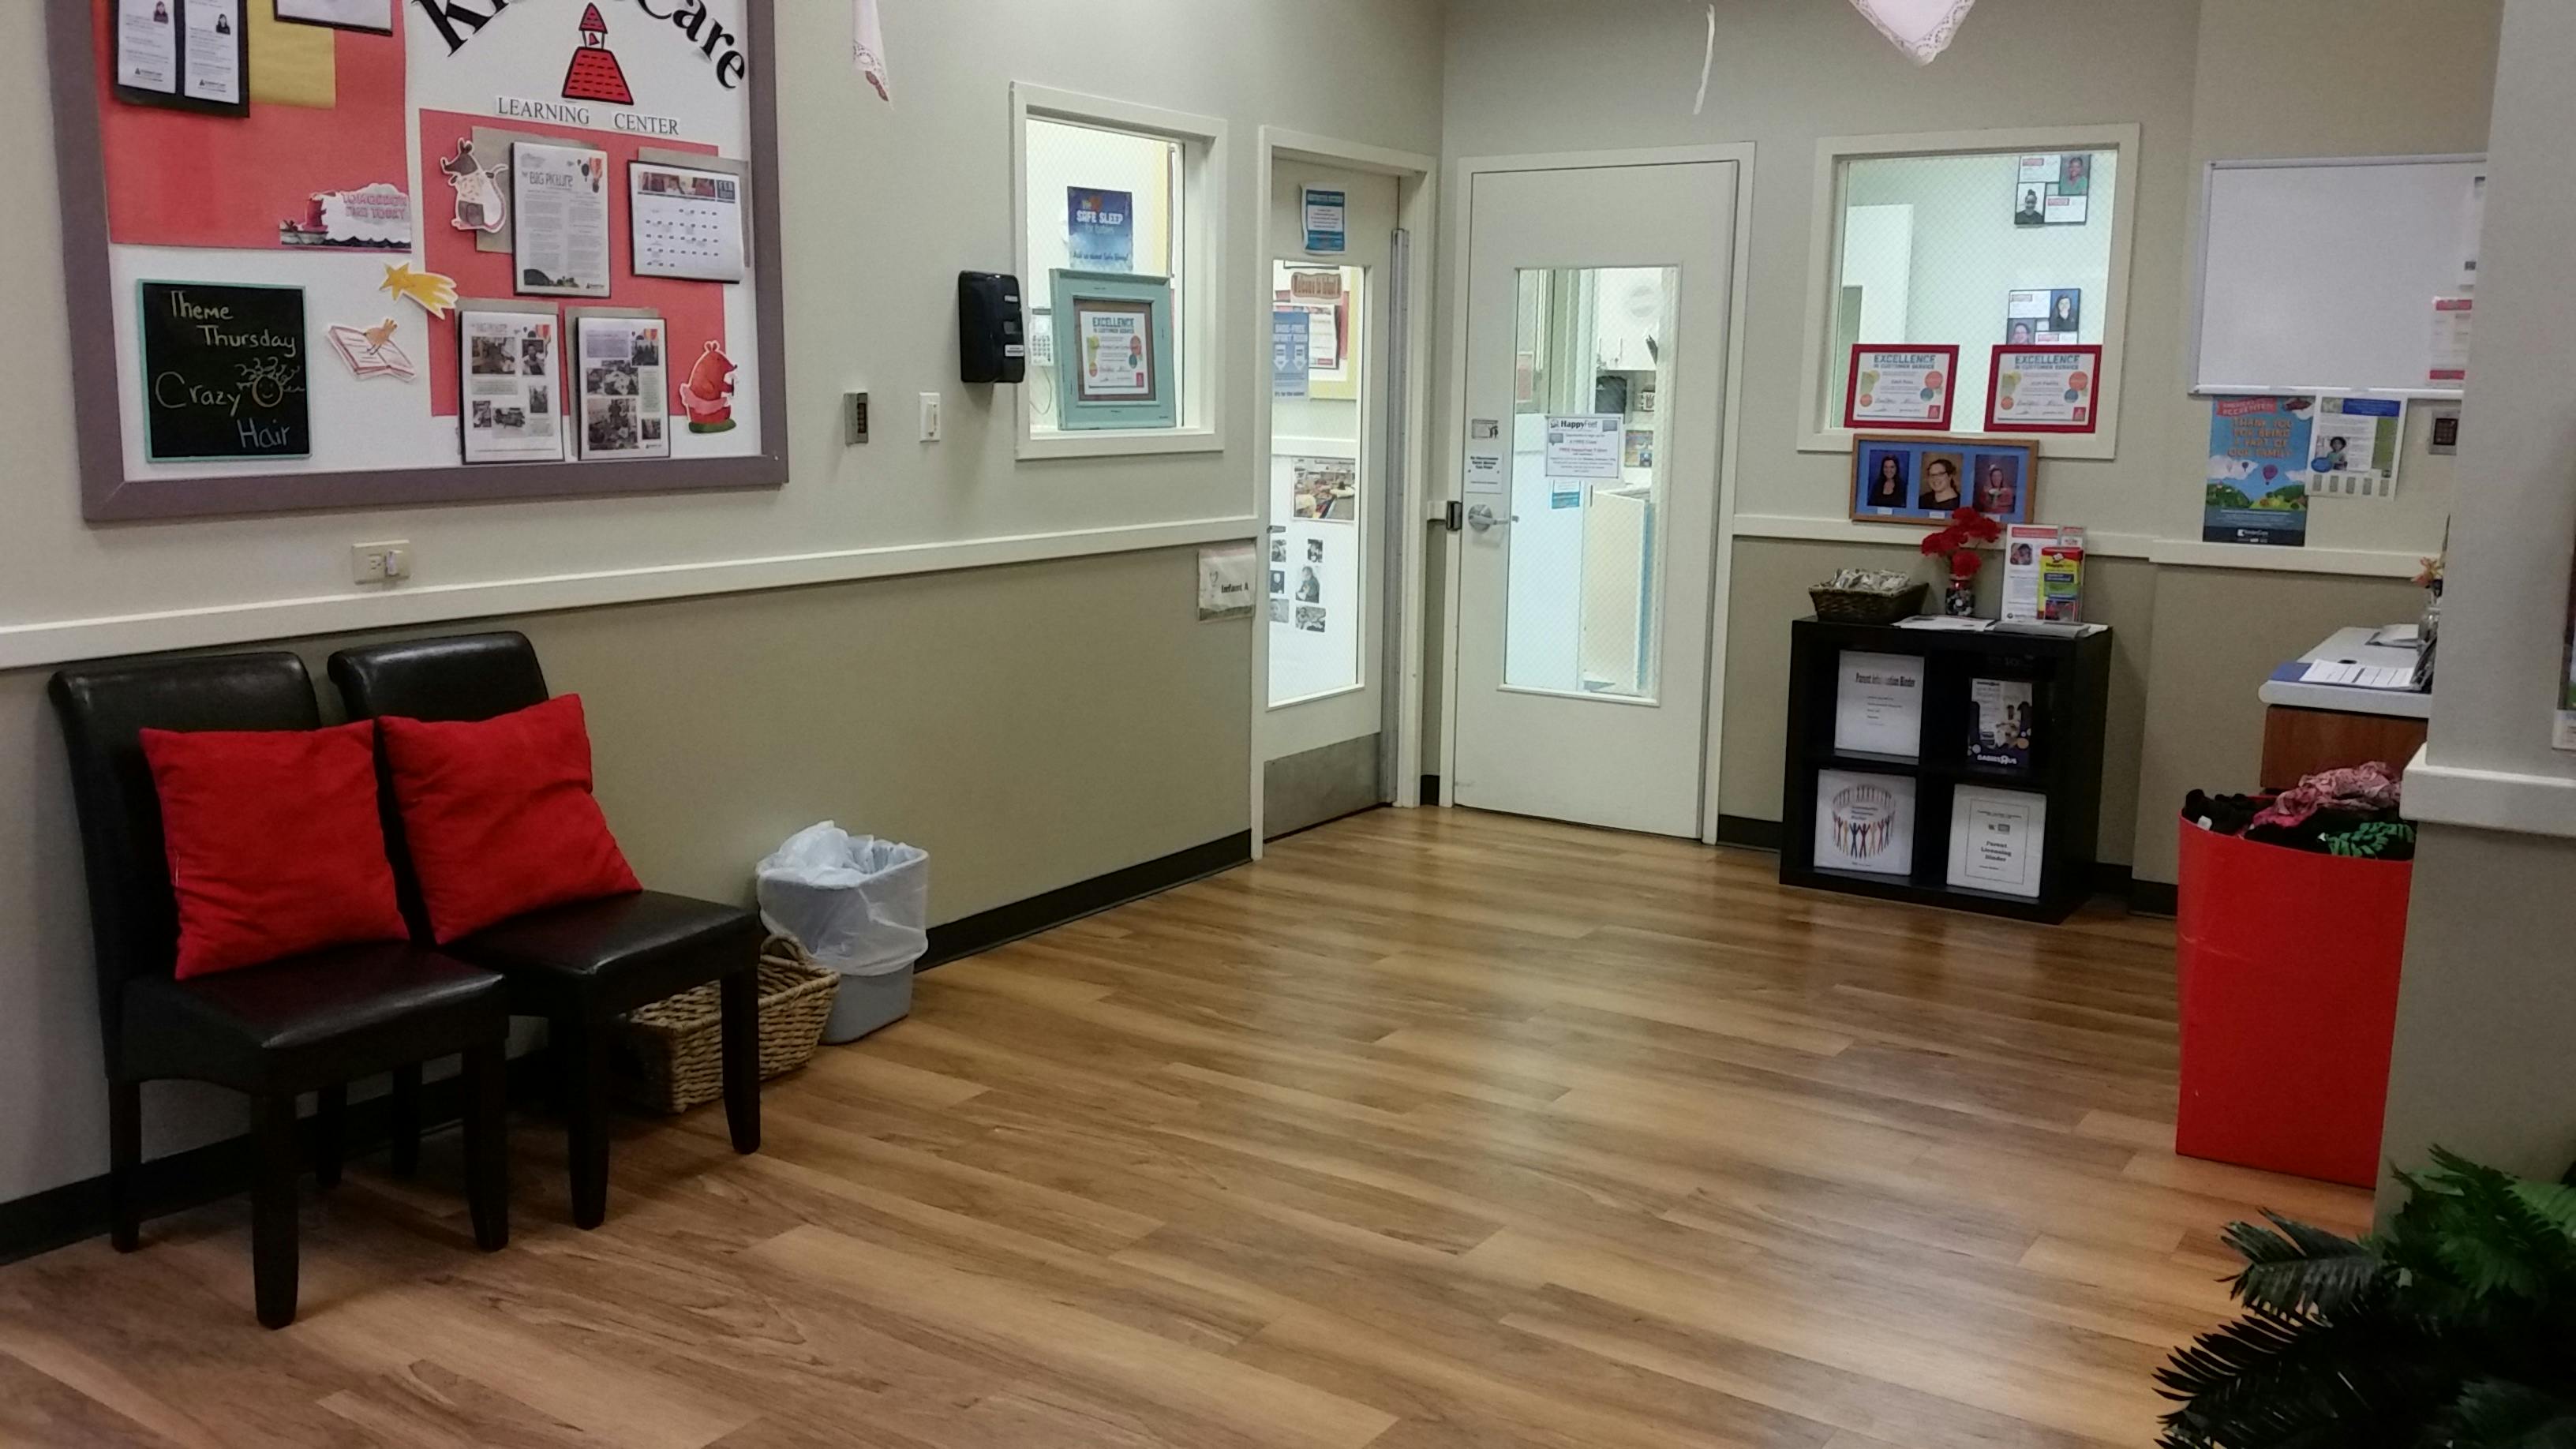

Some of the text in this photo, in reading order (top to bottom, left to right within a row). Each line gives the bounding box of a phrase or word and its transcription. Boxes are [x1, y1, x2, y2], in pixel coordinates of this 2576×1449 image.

[498, 97, 679, 135] LEARNING CENTER
[1076, 209, 1124, 225] SAFE SLEEP
[170, 290, 234, 320] Theme
[1092, 317, 1134, 328] EXCELLENCE
[197, 324, 297, 358] Thursday
[1874, 354, 1936, 364] EXCELLENCE
[2015, 354, 2080, 365] EXCELLENCE
[155, 371, 241, 417] Crazy
[1560, 420, 1598, 429] HappyFeet
[237, 417, 290, 448] Hair
[1221, 583, 1242, 593] Infant
[1856, 672, 1871, 684] Parent
[1900, 676, 1915, 687] Binder
[1981, 847, 2012, 857] Licensing
